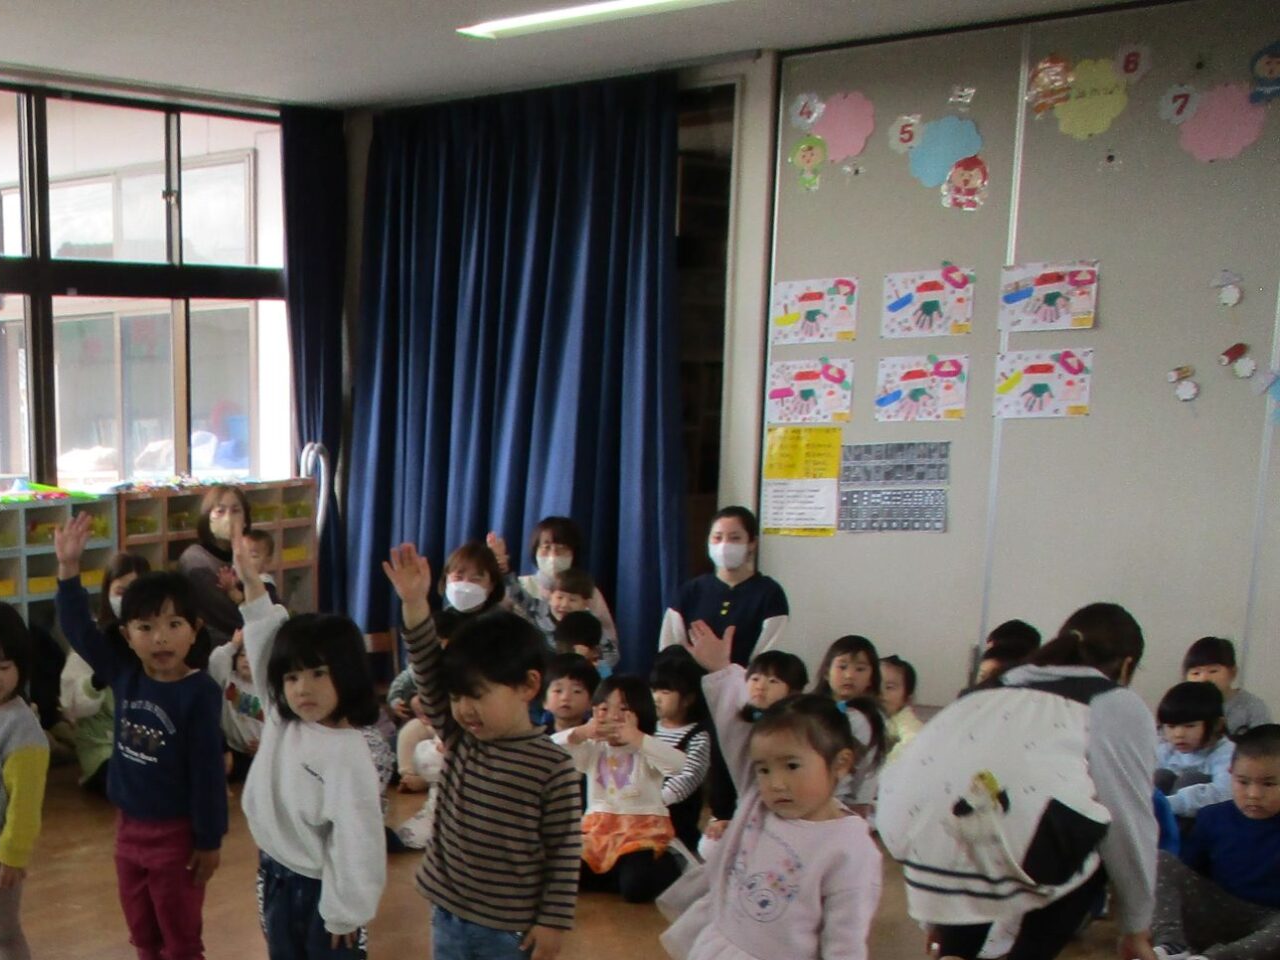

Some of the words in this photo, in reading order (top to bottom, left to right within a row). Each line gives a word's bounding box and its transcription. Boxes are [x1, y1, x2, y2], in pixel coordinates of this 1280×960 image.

[1124, 52, 1140, 74] 6
[799, 102, 812, 119] 4
[1172, 93, 1190, 116] 7
[899, 124, 914, 144] 5
